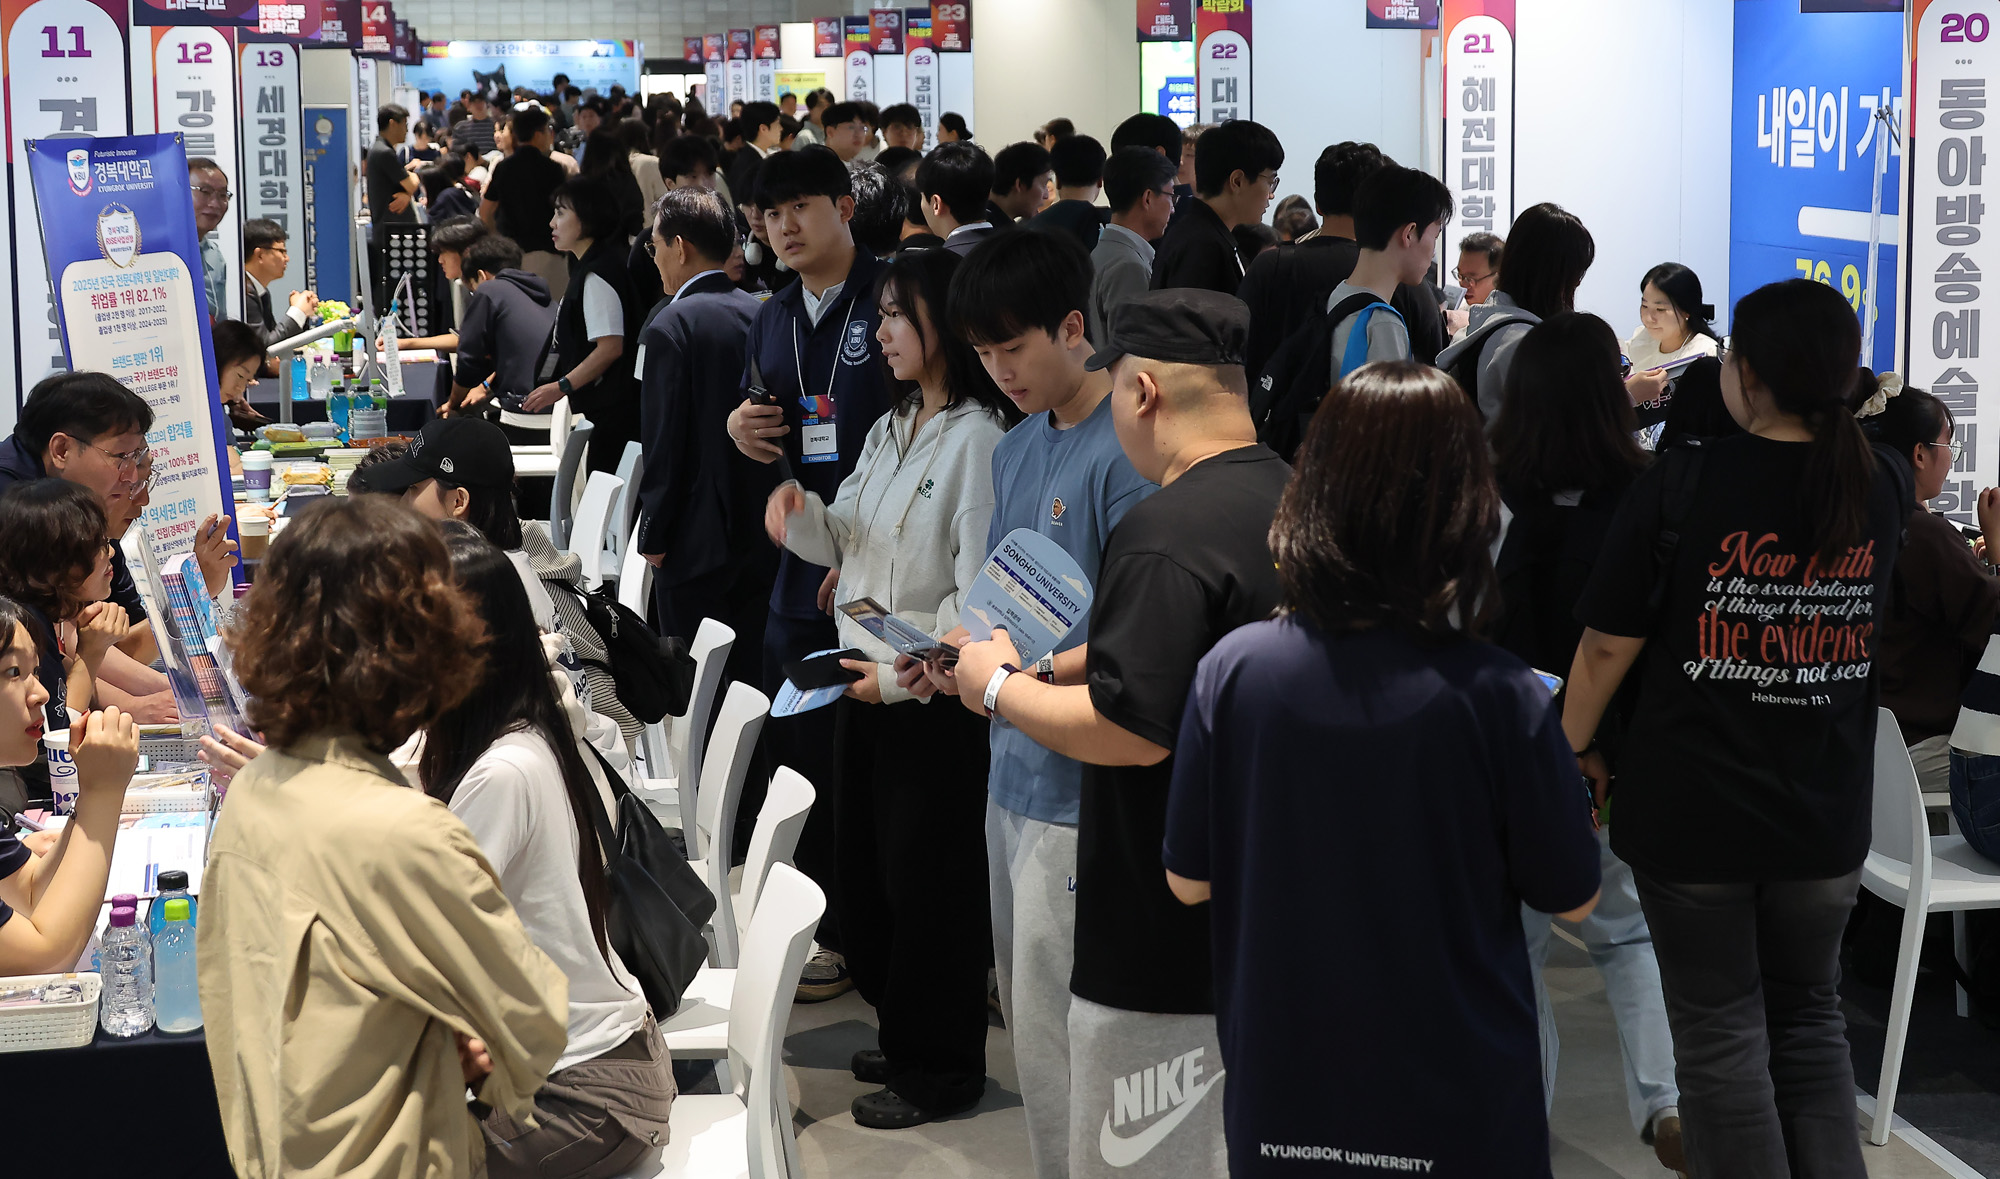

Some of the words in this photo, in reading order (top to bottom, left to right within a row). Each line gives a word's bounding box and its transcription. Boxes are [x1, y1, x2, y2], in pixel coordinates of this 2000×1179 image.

[874, 13, 899, 28] 23
[938, 4, 966, 21] 23
[1384, 6, 1420, 20] 대학교
[259, 19, 301, 34] 대학교
[817, 21, 839, 34] 24
[1151, 25, 1178, 35] 대학교
[1940, 12, 1990, 43] 20
[41, 26, 92, 58] 11
[1211, 43, 1238, 59] 22
[1463, 33, 1495, 54] 21
[177, 42, 213, 64] 12
[256, 50, 284, 67] 13
[852, 57, 867, 66] 24
[915, 55, 931, 65] 23
[1168, 95, 1196, 112] 수도
[1757, 86, 1849, 172] 내일이
[73, 172, 87, 181] KBU
[94, 160, 154, 184] 경복대학교
[98, 184, 126, 193] KYUNGBOK
[126, 181, 155, 191] UNIVERSITY
[72, 277, 100, 292] 2025년
[100, 277, 116, 290] 전국
[115, 273, 144, 288] 전문대학
[144, 272, 152, 284] 및
[152, 267, 180, 282] 일반대학
[91, 292, 118, 310] 취업률
[120, 289, 135, 306] 1위
[136, 287, 168, 303] 82.1%
[112, 355, 134, 369] 브랜드
[133, 352, 148, 367] 평판
[148, 345, 164, 363] 1위
[133, 370, 147, 383] 국가
[147, 368, 166, 381] 브랜드
[166, 365, 178, 378] 대상
[135, 383, 158, 394] COLLEGE
[166, 420, 194, 442] 합격률
[168, 456, 187, 469] 100%
[187, 452, 200, 466] 합격
[150, 503, 178, 524] 역세권
[178, 498, 197, 515] 대학
[1708, 530, 1799, 578] Now
[1003, 544, 1037, 577] SONGHO
[1035, 573, 1081, 615] UNIVERSITY
[1706, 576, 1723, 593] is
[1727, 576, 1760, 596] the
[1704, 595, 1727, 615] of
[1726, 595, 1786, 622] things
[1788, 598, 1850, 621] hoped
[1845, 598, 1873, 622] for,
[1698, 603, 1749, 661] the
[1760, 611, 1874, 664] evidence
[1683, 655, 1710, 682] of
[1708, 655, 1791, 688] things
[1795, 661, 1832, 684] not
[1752, 691, 1808, 706] Hebrews
[1811, 694, 1832, 706] 11:1
[1114, 1046, 1205, 1128] NIKE
[1260, 1143, 1344, 1164] KYUNGBOK
[1345, 1152, 1434, 1174] UNIVERSITY
